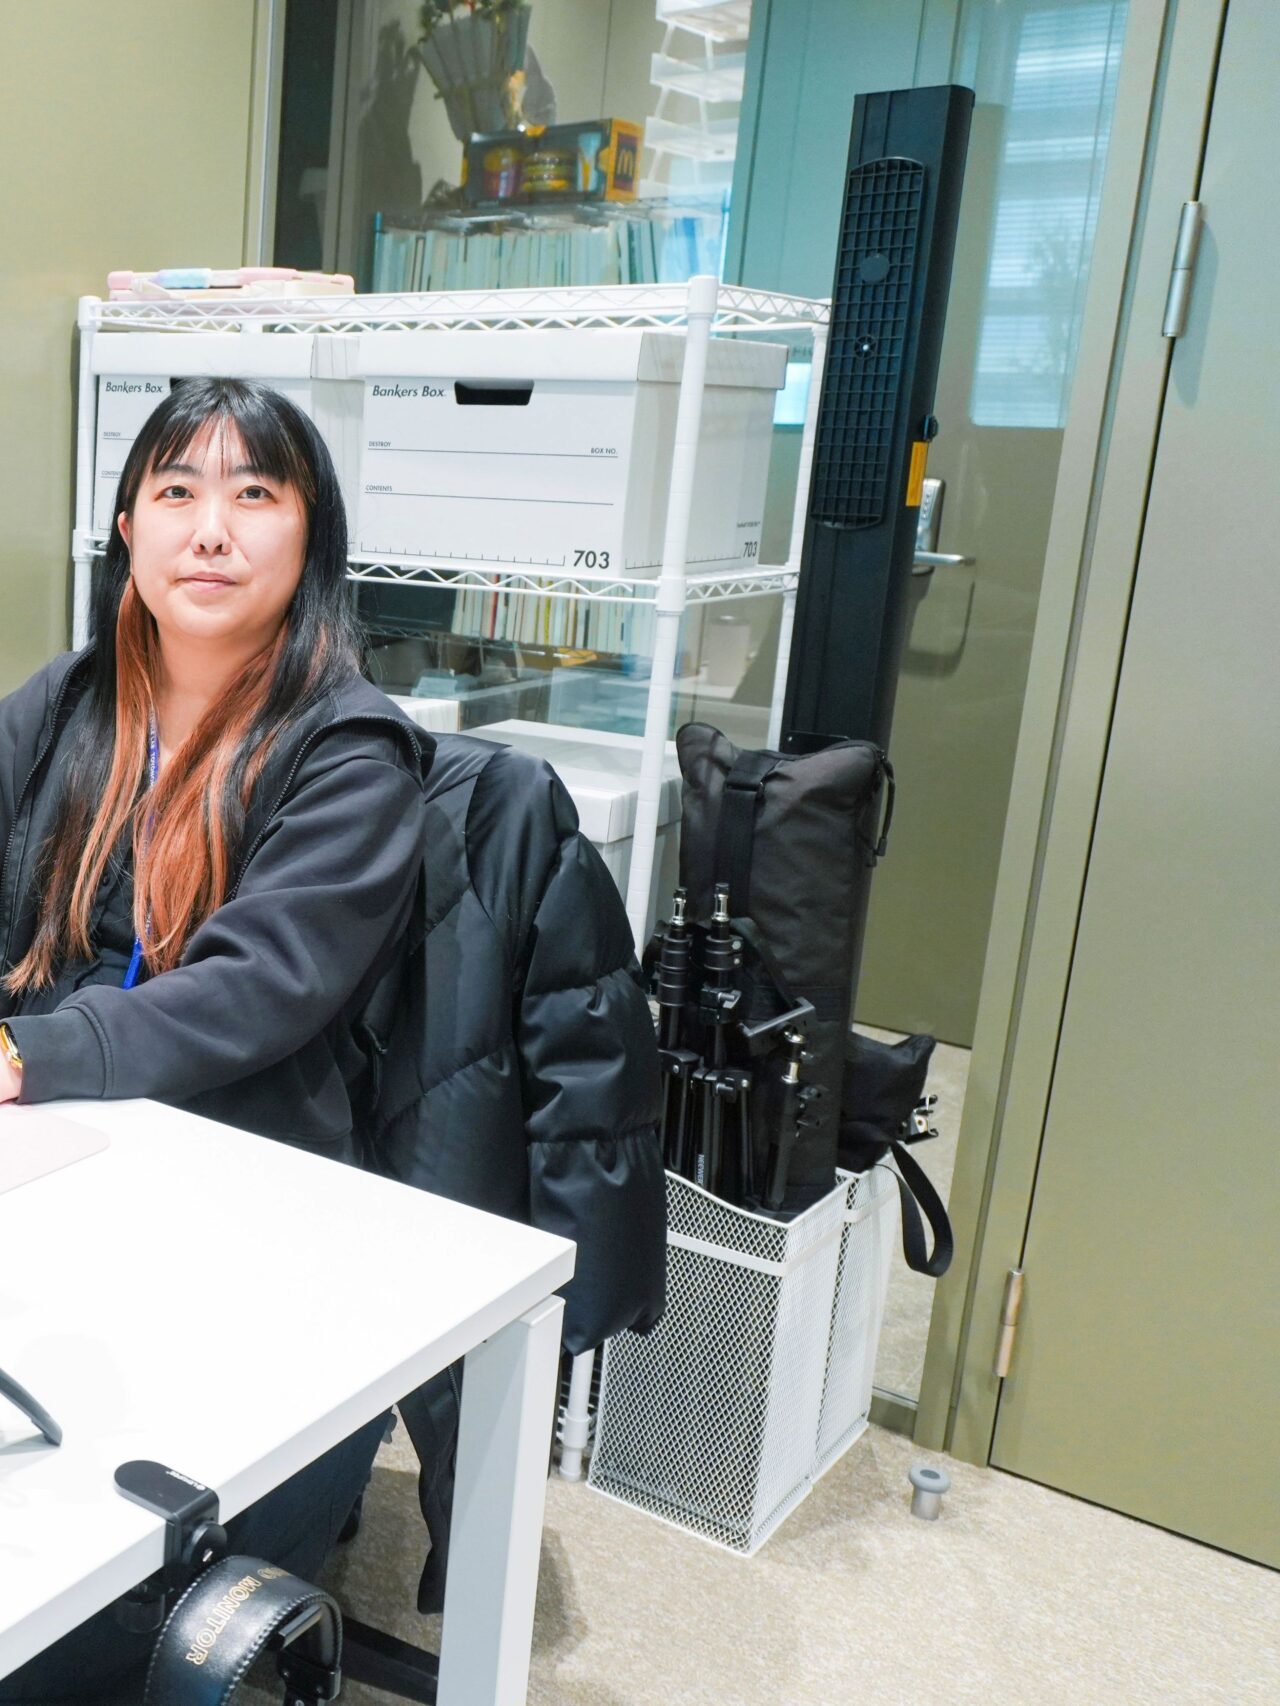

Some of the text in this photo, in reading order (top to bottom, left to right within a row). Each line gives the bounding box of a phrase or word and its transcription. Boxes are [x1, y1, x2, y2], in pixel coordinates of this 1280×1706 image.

[105, 380, 163, 394] Bankers Box
[372, 383, 445, 398] Bankers Box
[365, 484, 393, 492] CONTENTS
[743, 540, 758, 558] 703
[573, 549, 610, 569] 703
[185, 1575, 263, 1666] MONITOR
